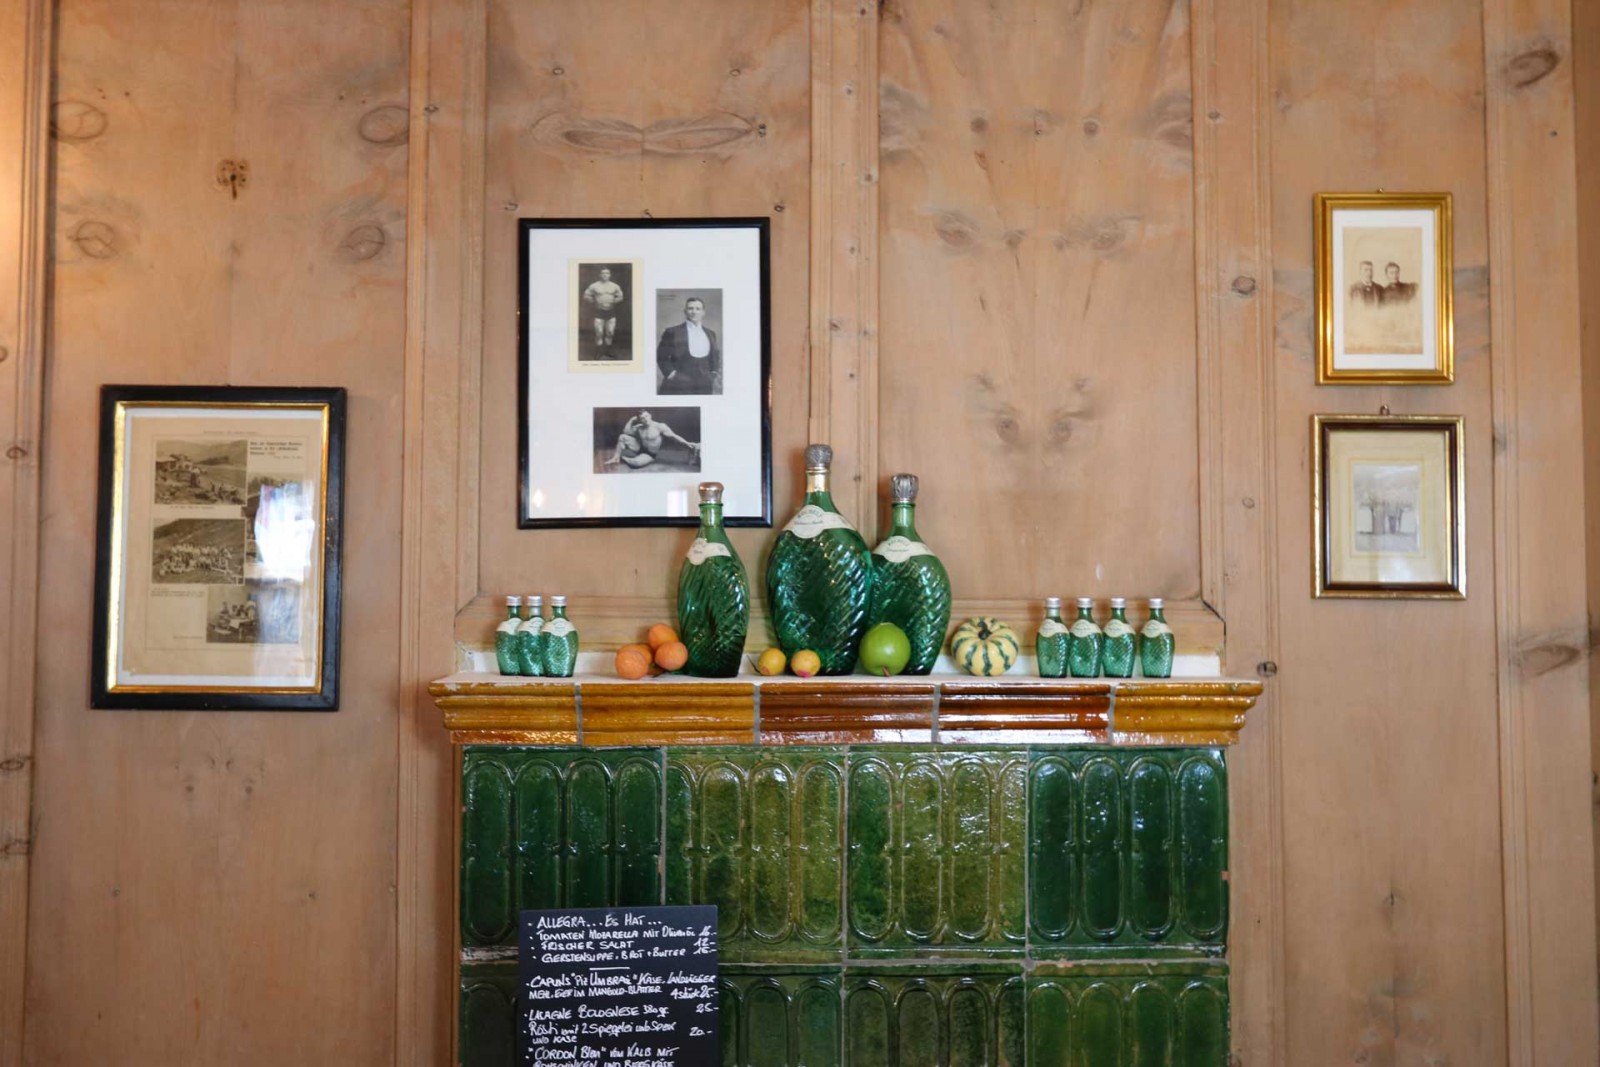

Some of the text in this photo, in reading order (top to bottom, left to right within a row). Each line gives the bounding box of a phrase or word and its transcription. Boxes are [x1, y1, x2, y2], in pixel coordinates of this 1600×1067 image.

[541, 941, 595, 951] FRISCHER
[599, 940, 635, 950] SALAT
[621, 949, 645, 960] BROT
[530, 973, 571, 988] CAPUNS
[529, 1008, 572, 1021] LASAGNE
[578, 1004, 640, 1018] BOLOGNESE
[627, 1041, 651, 1057] KALB
